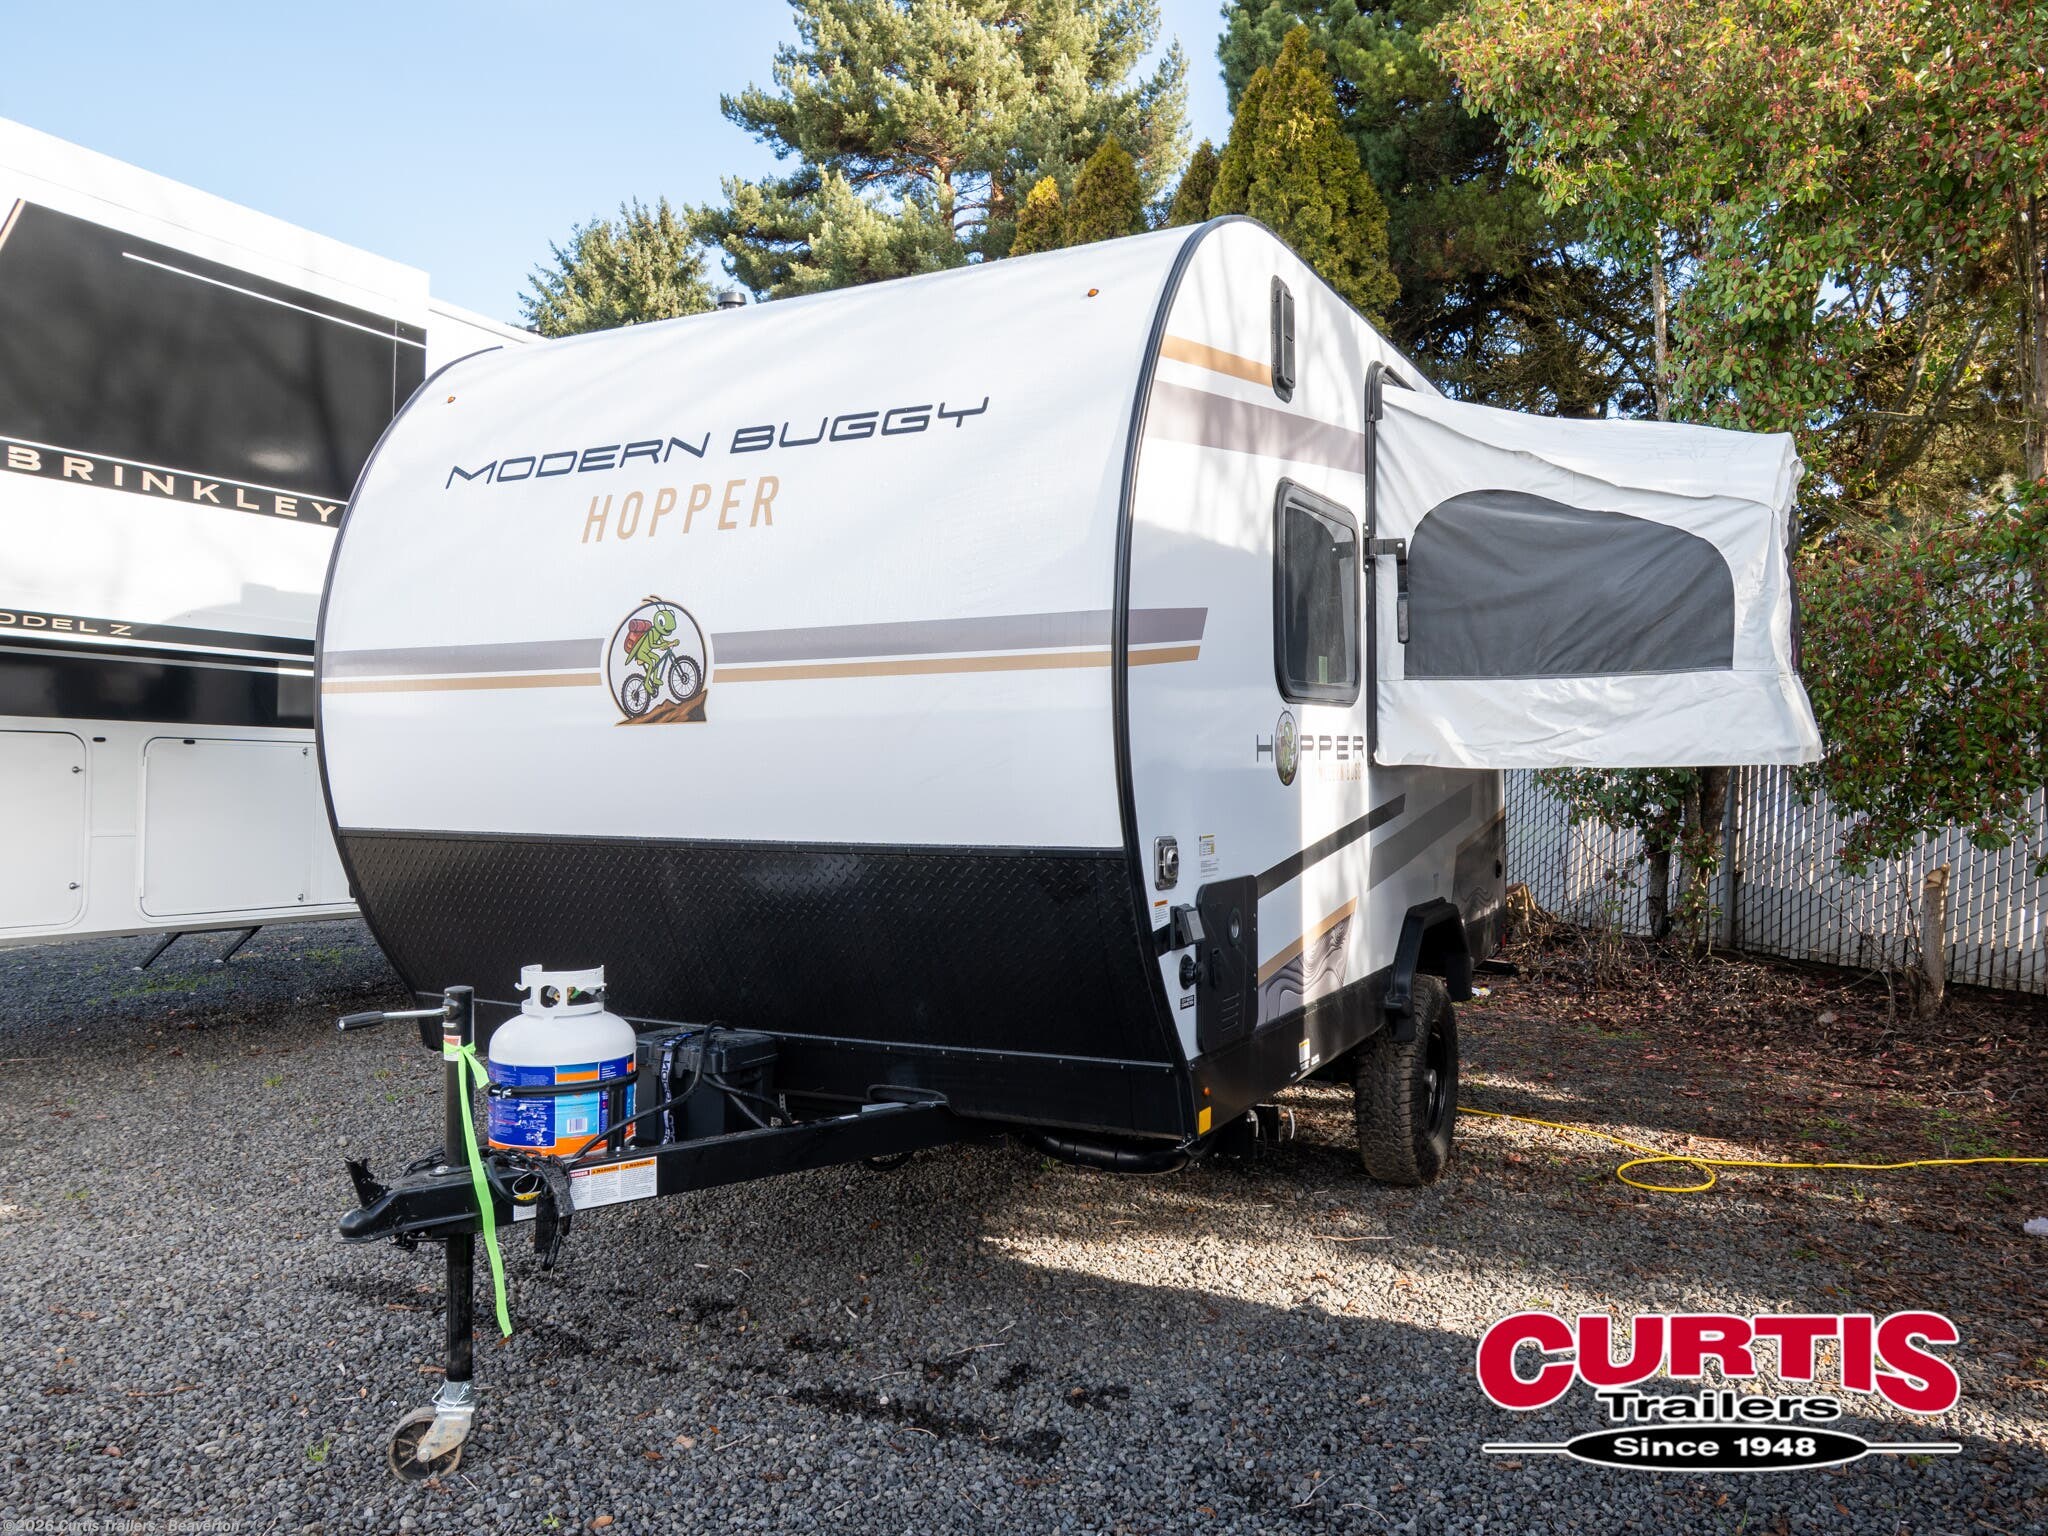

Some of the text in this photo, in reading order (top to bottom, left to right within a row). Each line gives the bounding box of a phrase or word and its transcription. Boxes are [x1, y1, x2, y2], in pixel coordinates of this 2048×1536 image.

[445, 396, 990, 489] MODERN BUGGY
[7, 445, 338, 523] BRINKLEY
[581, 475, 780, 544] HOPPER
[110, 623, 132, 636] Z
